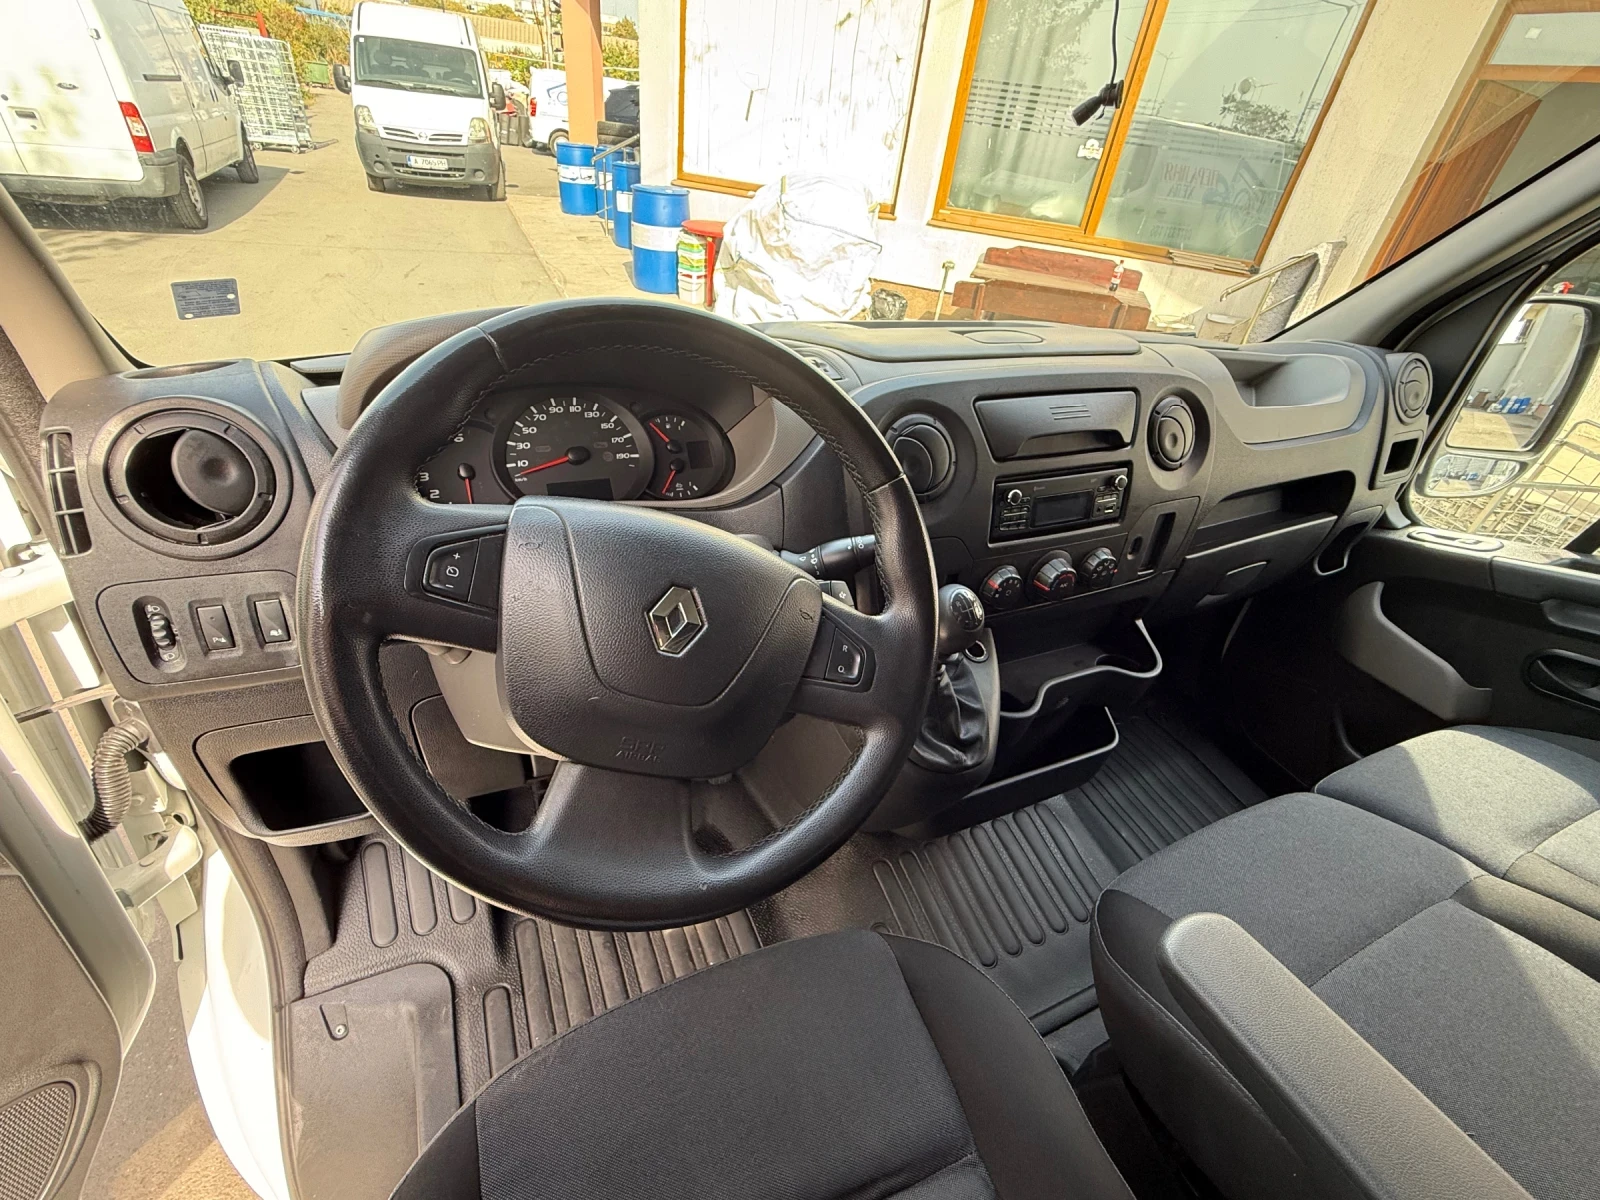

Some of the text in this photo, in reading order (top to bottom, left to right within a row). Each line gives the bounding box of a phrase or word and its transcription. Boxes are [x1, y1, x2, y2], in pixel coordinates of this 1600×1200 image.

[569, 405, 582, 413] 110
[522, 426, 537, 434] 50
[516, 442, 531, 450] 30
[419, 472, 430, 482] 3
[429, 489, 440, 499] 2
